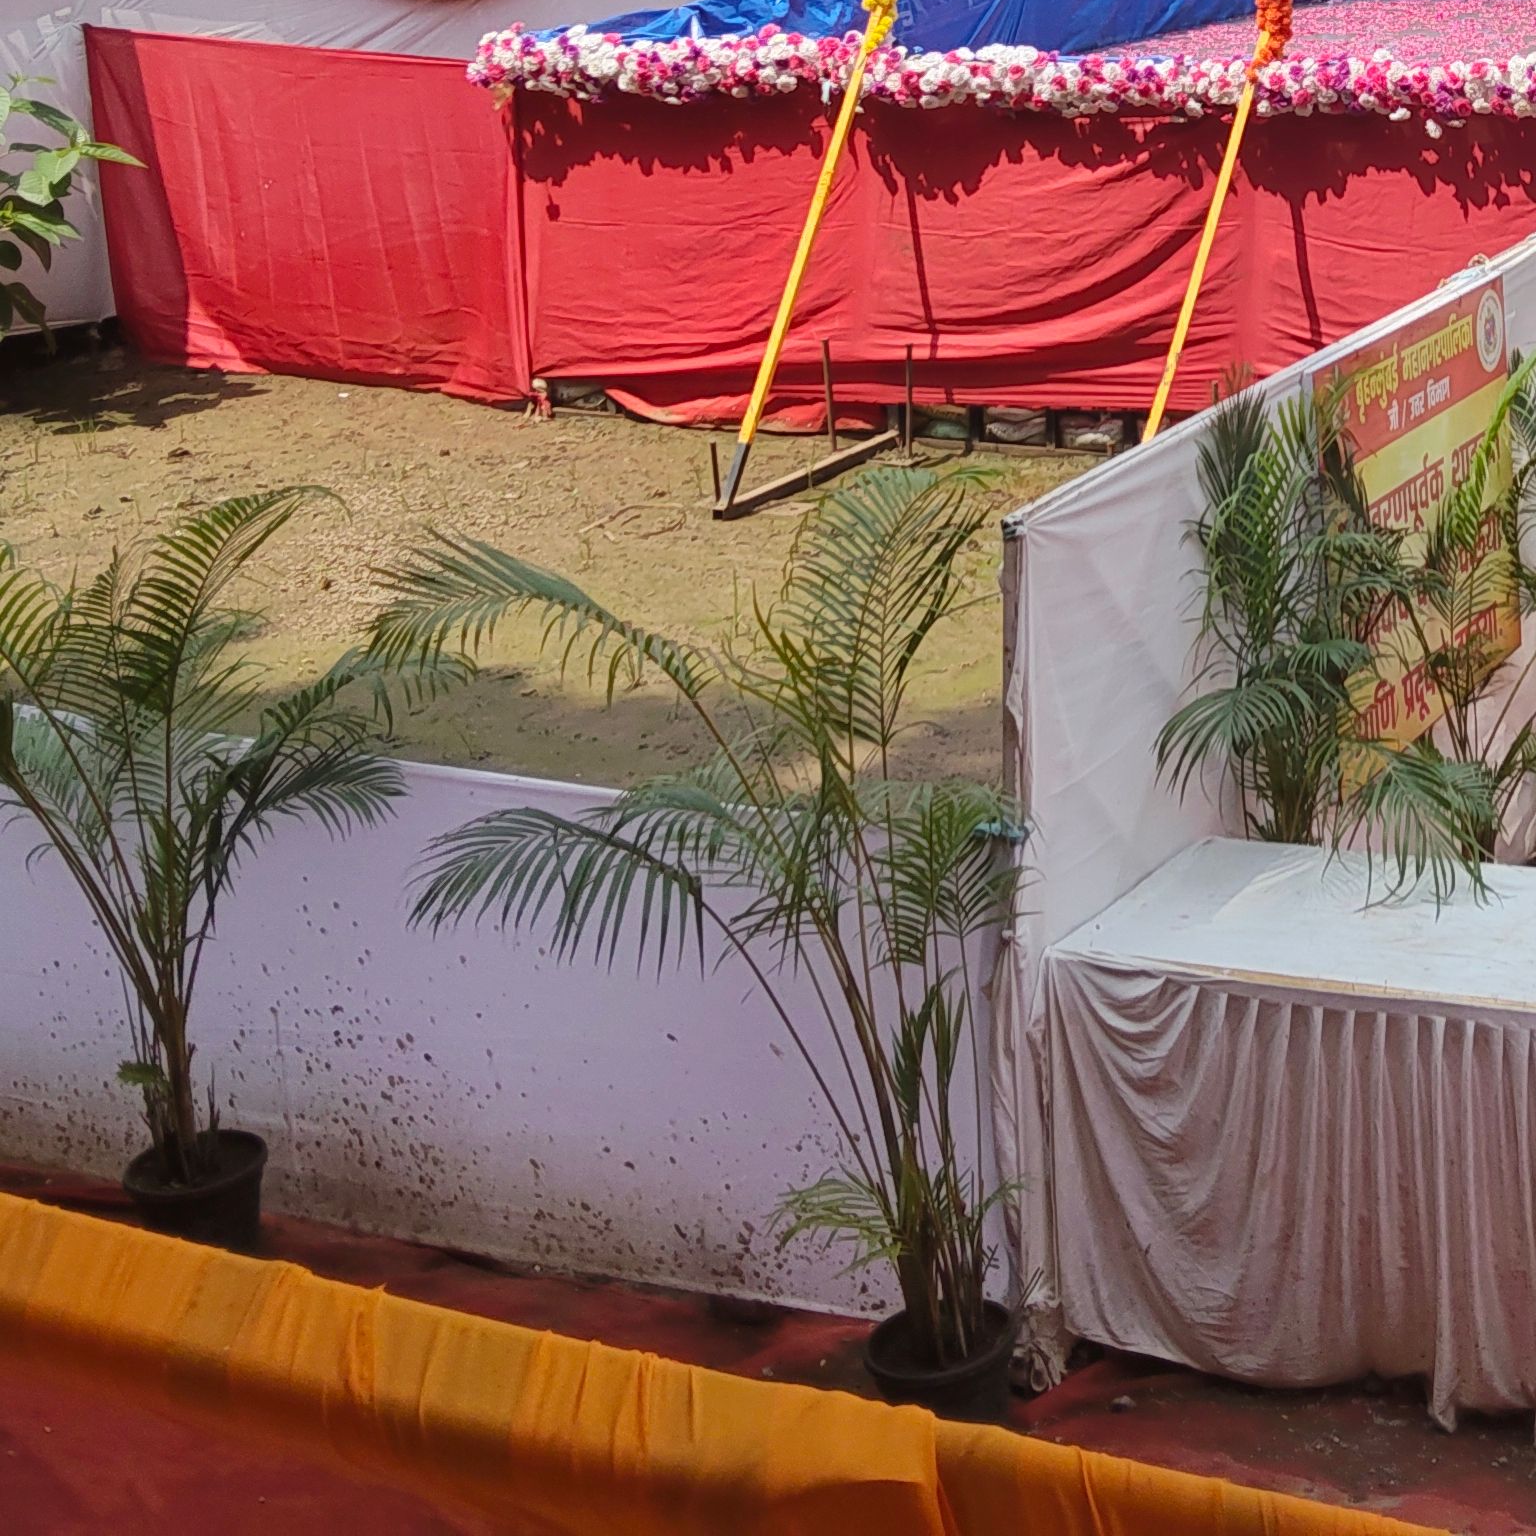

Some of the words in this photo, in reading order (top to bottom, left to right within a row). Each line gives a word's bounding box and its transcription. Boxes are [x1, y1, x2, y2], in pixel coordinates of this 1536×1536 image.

[1400, 313, 1474, 382] महानगरपालिका
[1388, 402, 1399, 431] जी
[1426, 376, 1450, 408] विभाग
